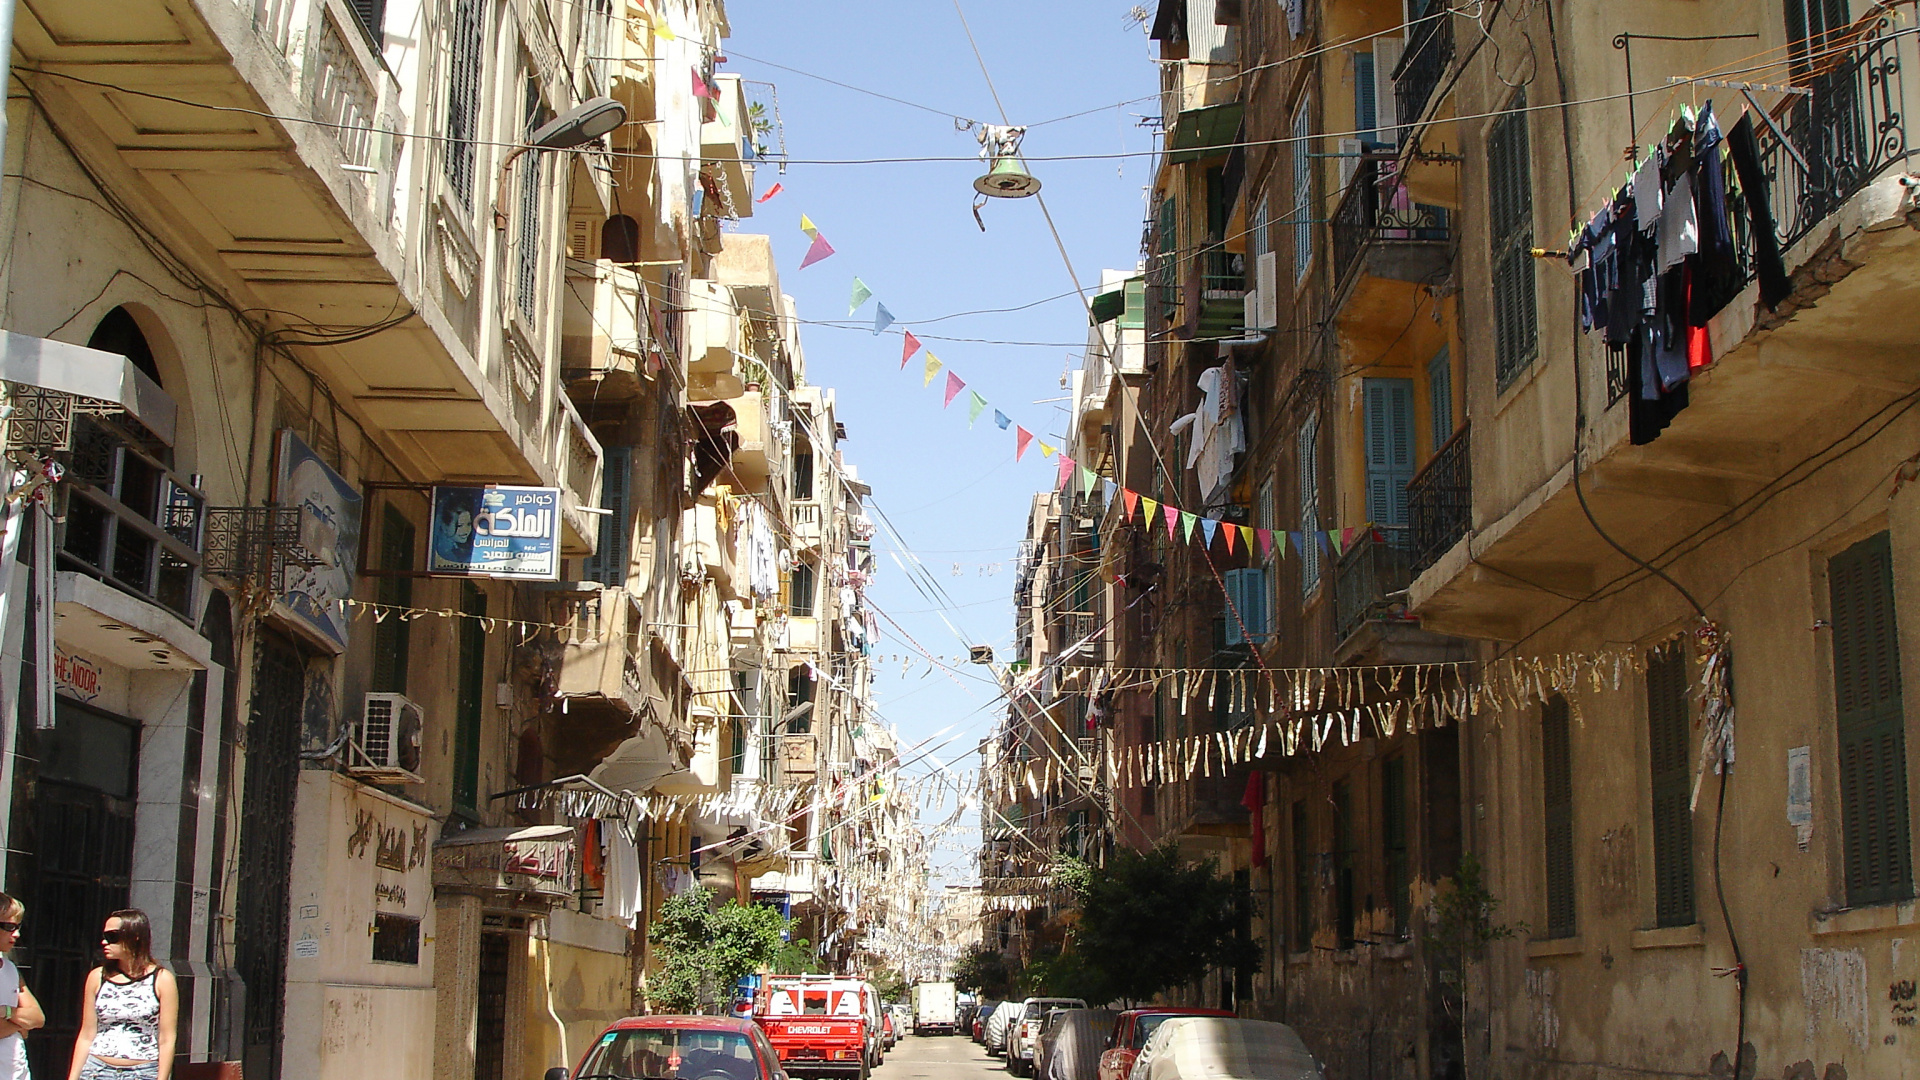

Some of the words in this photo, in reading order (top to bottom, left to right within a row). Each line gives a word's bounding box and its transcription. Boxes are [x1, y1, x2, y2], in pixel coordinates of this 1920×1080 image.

[515, 493, 553, 506] كوافير
[472, 507, 551, 538] الملكة
[72, 663, 97, 693] NOOR
[787, 1026, 832, 1034] CHEVROLET
